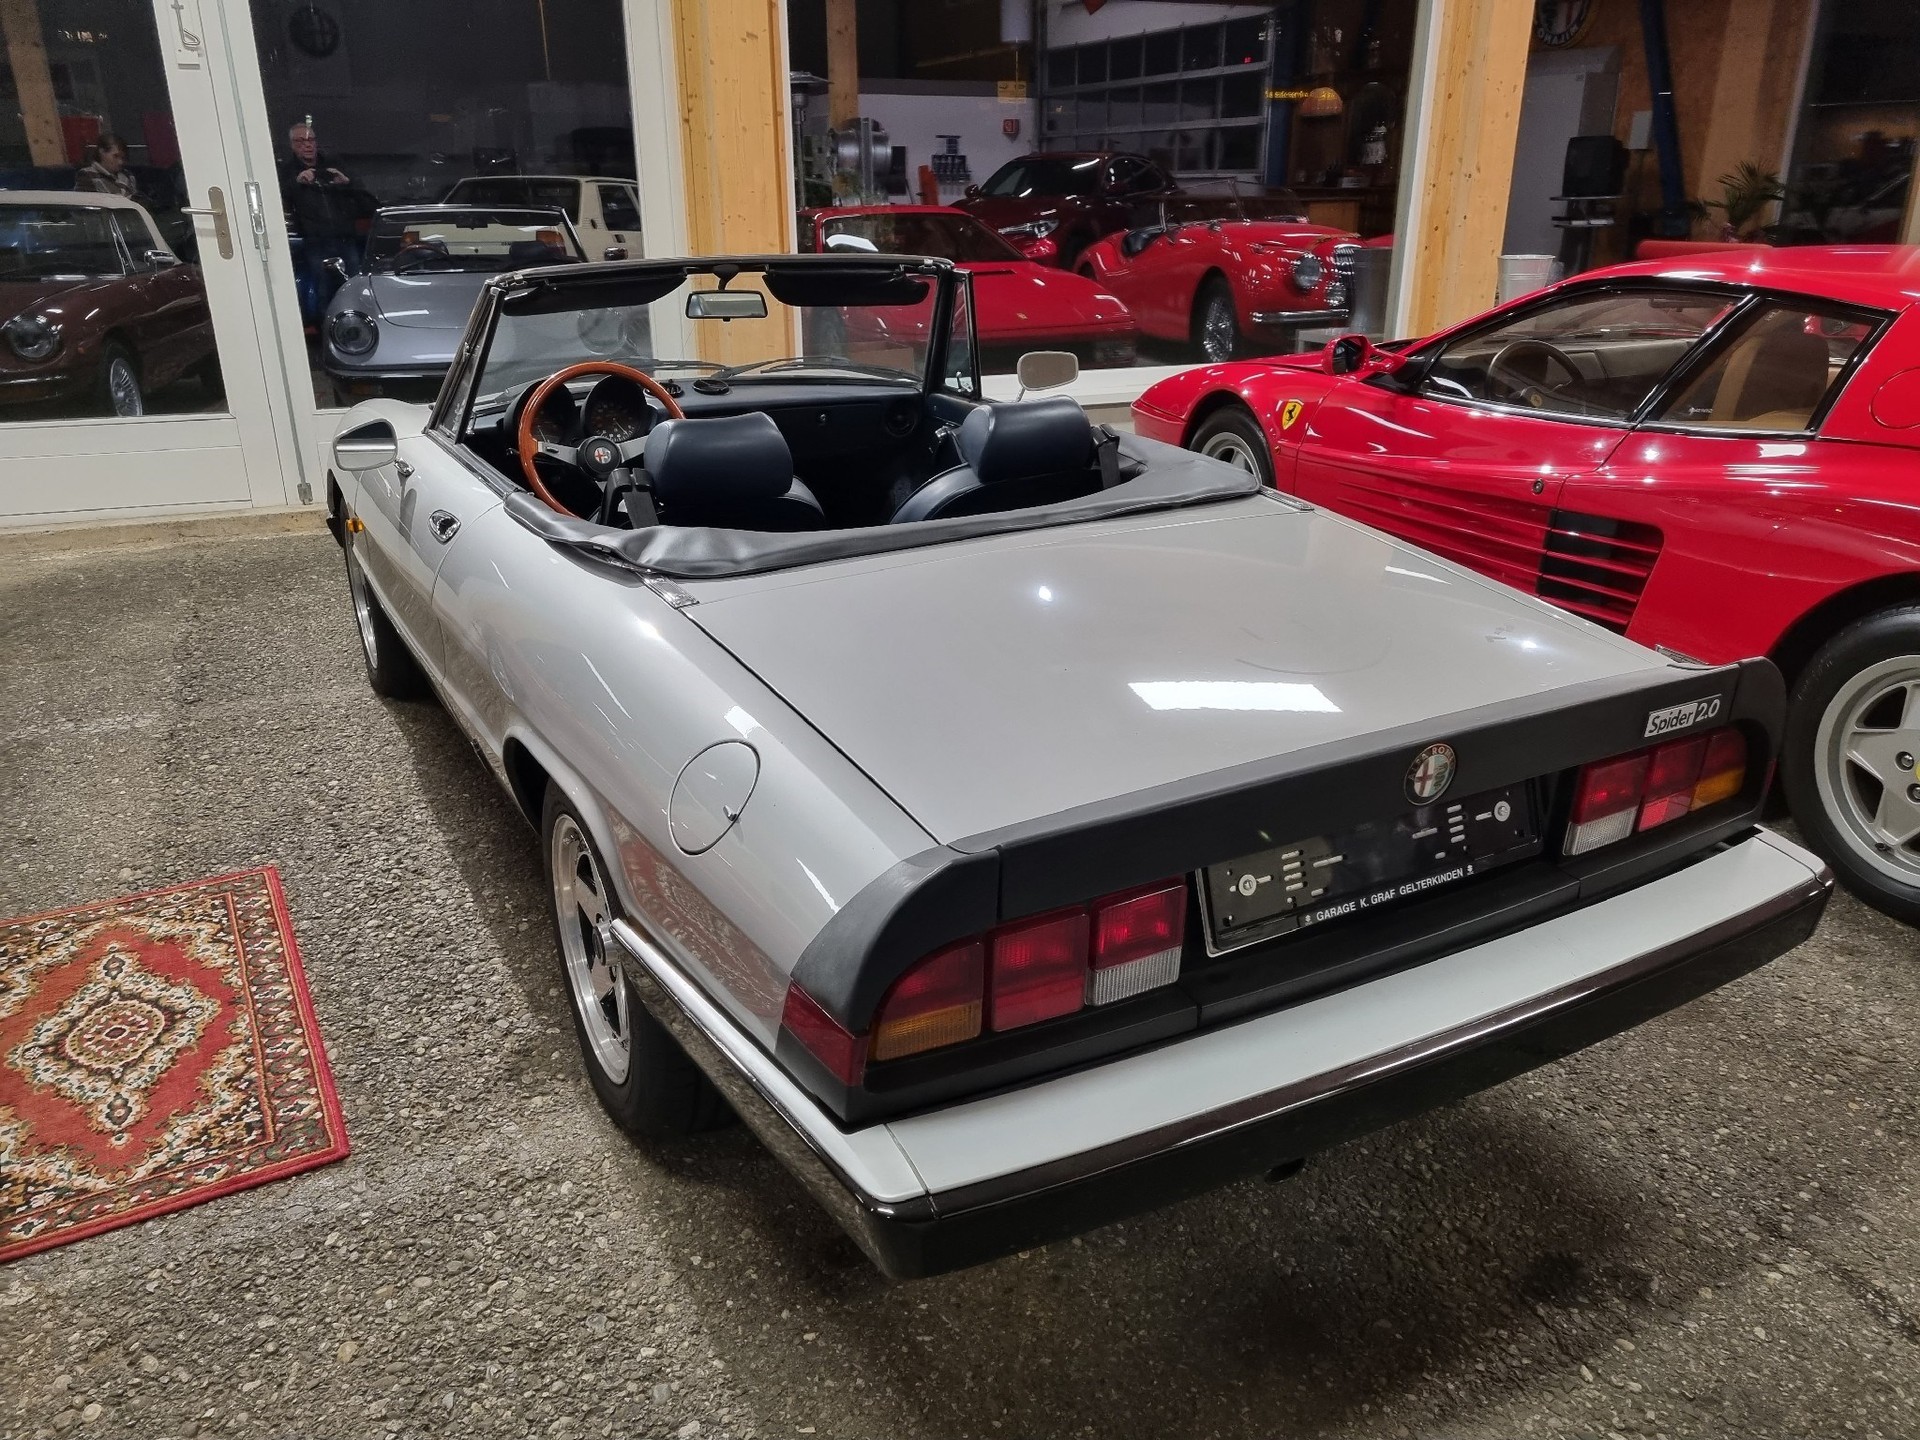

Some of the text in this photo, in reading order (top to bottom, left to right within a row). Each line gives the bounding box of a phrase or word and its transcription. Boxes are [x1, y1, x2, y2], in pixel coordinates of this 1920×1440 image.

[1648, 699, 1720, 734] Spider 2.0
[1316, 867, 1463, 921] GARAGE K. GRAF GELTERKINDEN
